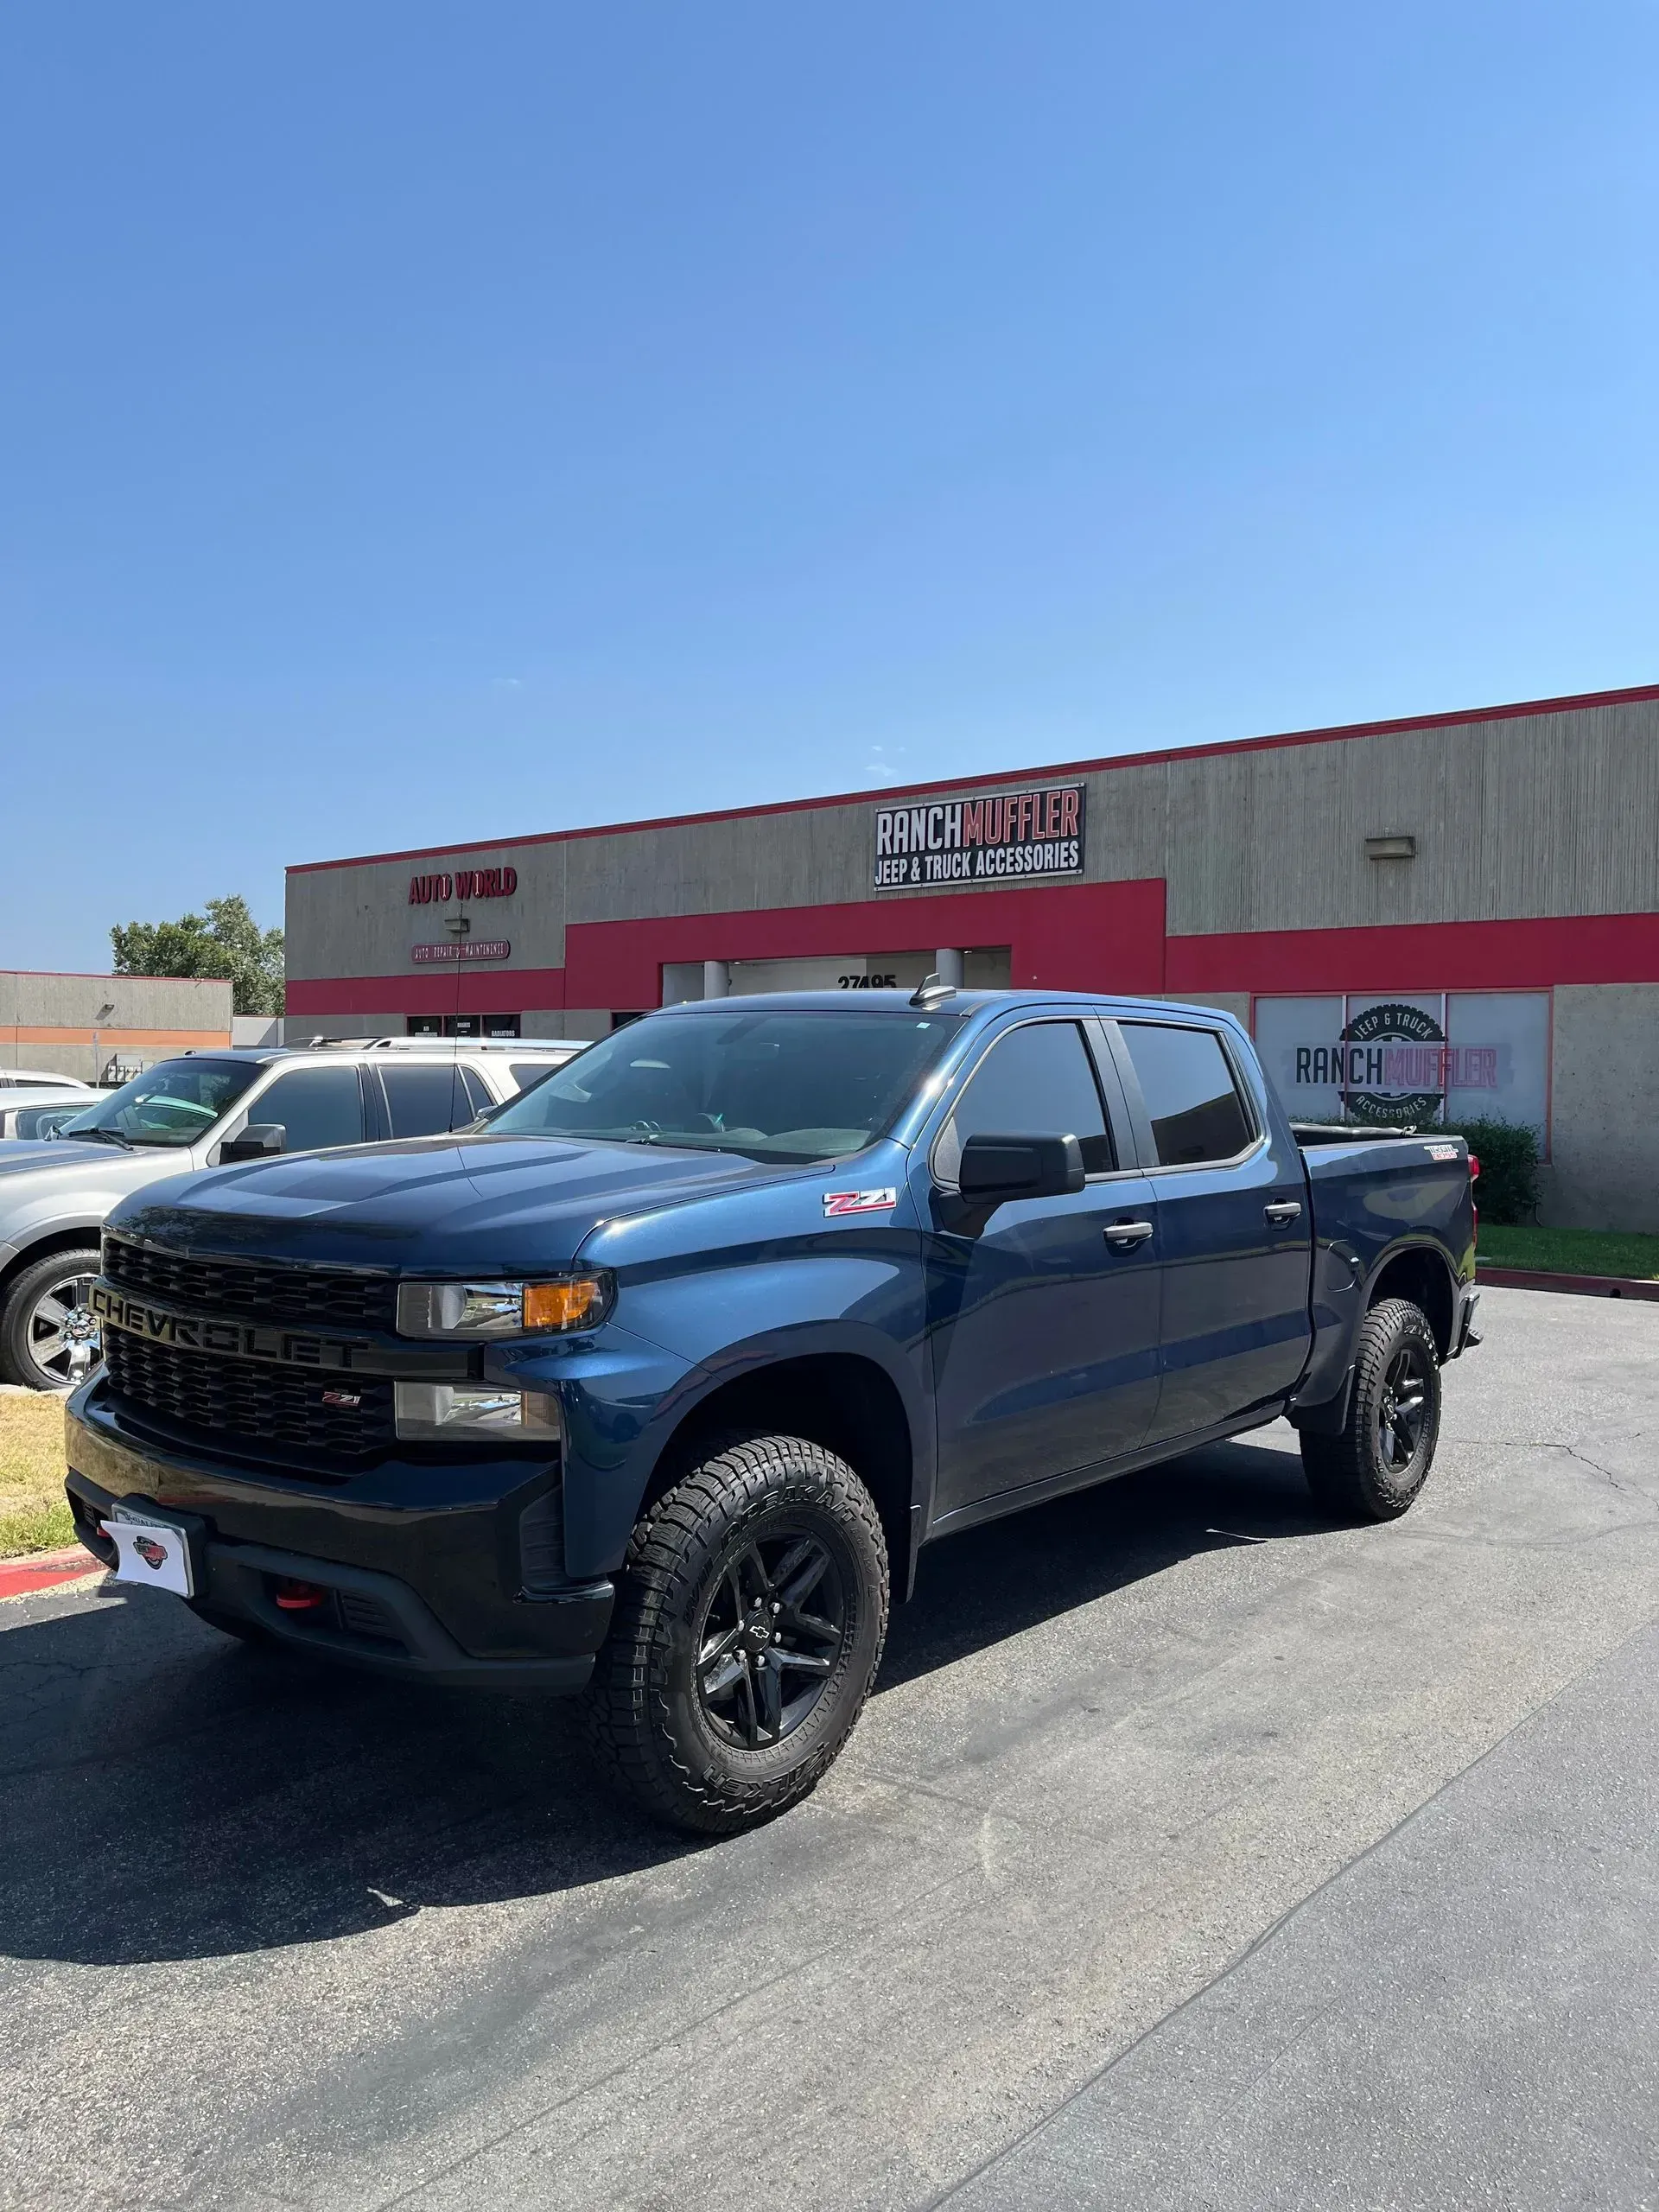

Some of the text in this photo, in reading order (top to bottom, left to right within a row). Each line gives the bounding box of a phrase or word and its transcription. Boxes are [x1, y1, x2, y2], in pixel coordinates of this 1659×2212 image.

[874, 840, 1079, 885] JEEP & TRUCK ACCESSORIES
[408, 867, 518, 905] AUTO WORLD
[415, 947, 429, 959] AUTO
[1354, 1012, 1433, 1040] JEEP & TRUCK
[1356, 1095, 1427, 1119] ACCESSORIES
[823, 1187, 896, 1217] Z71
[92, 1290, 370, 1369] CHEVROLET
